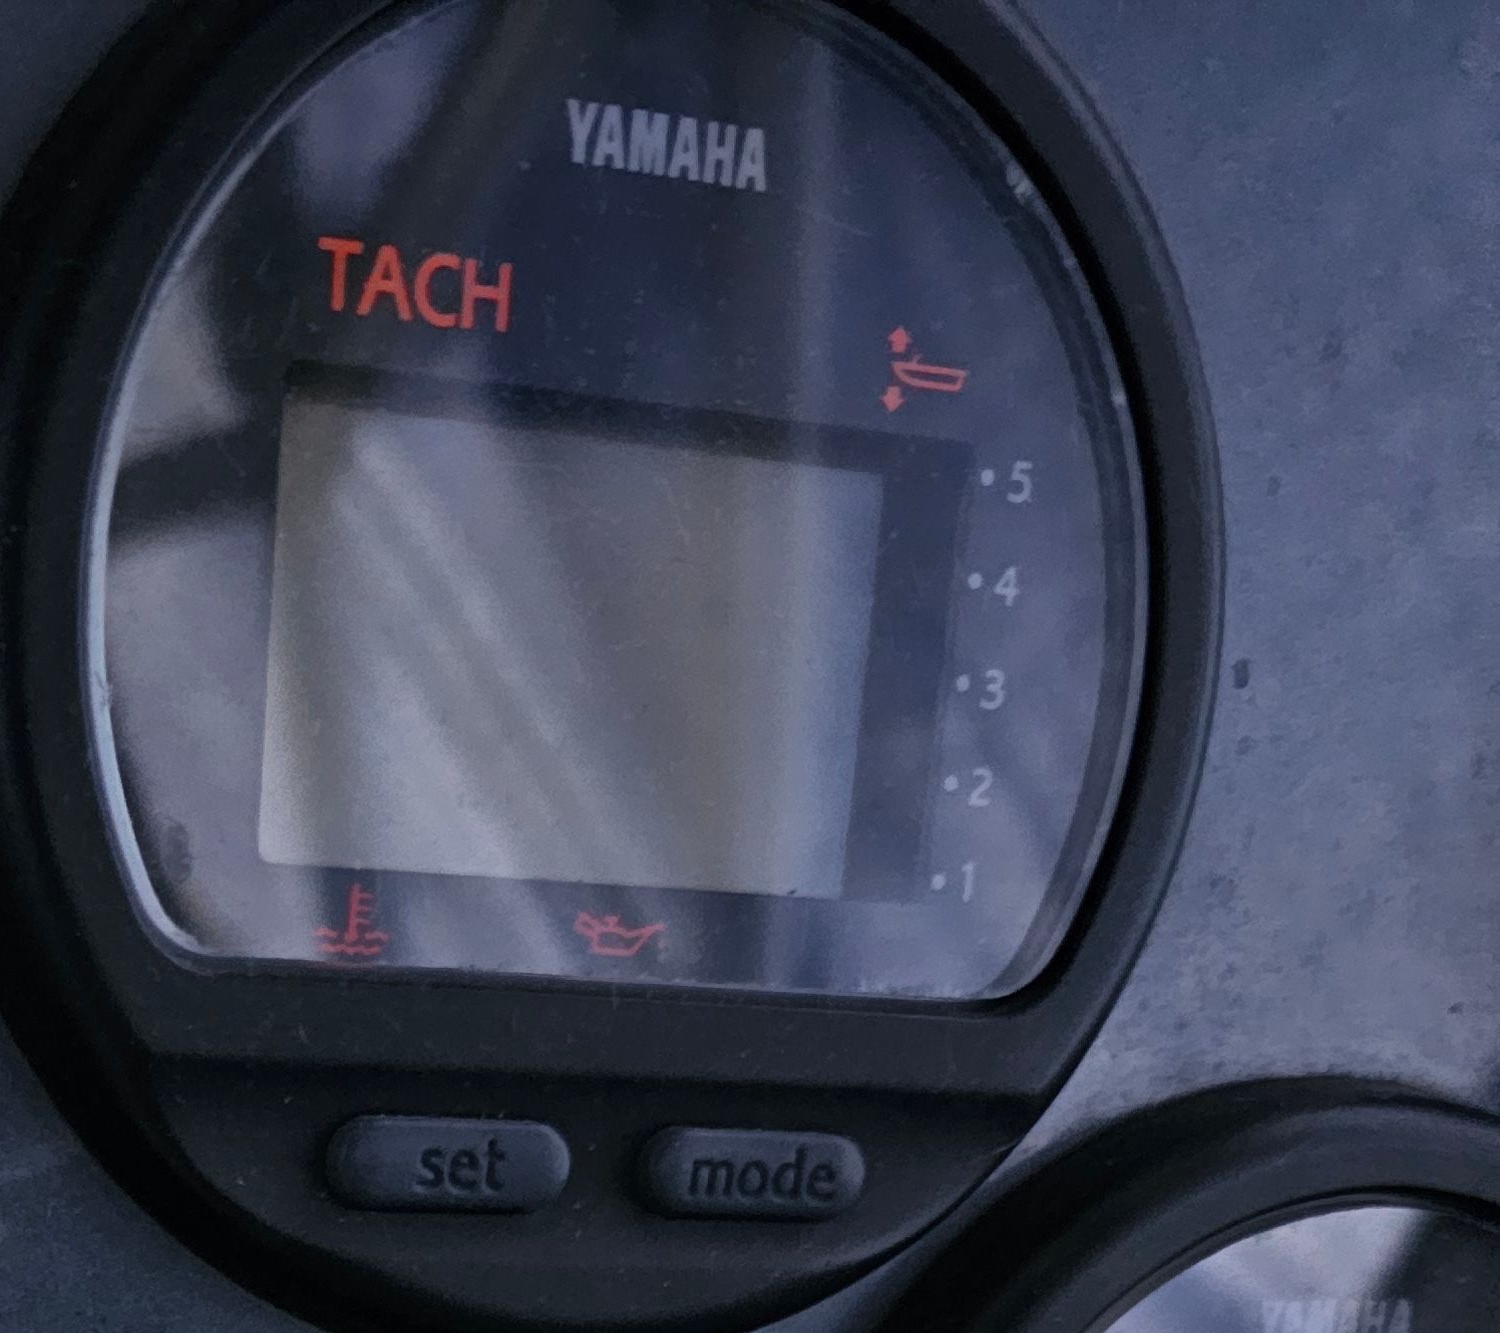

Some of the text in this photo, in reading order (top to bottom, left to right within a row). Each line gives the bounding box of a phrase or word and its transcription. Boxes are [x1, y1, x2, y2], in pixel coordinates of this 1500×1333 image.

[564, 98, 768, 193] YAMAHA
[316, 235, 513, 332] TACH
[1006, 460, 1034, 504] 5
[993, 566, 1020, 607] 4
[979, 668, 1005, 711] 3
[968, 767, 994, 807] 2
[961, 861, 976, 902] 1
[416, 1137, 506, 1193] set
[687, 1145, 838, 1201] mode
